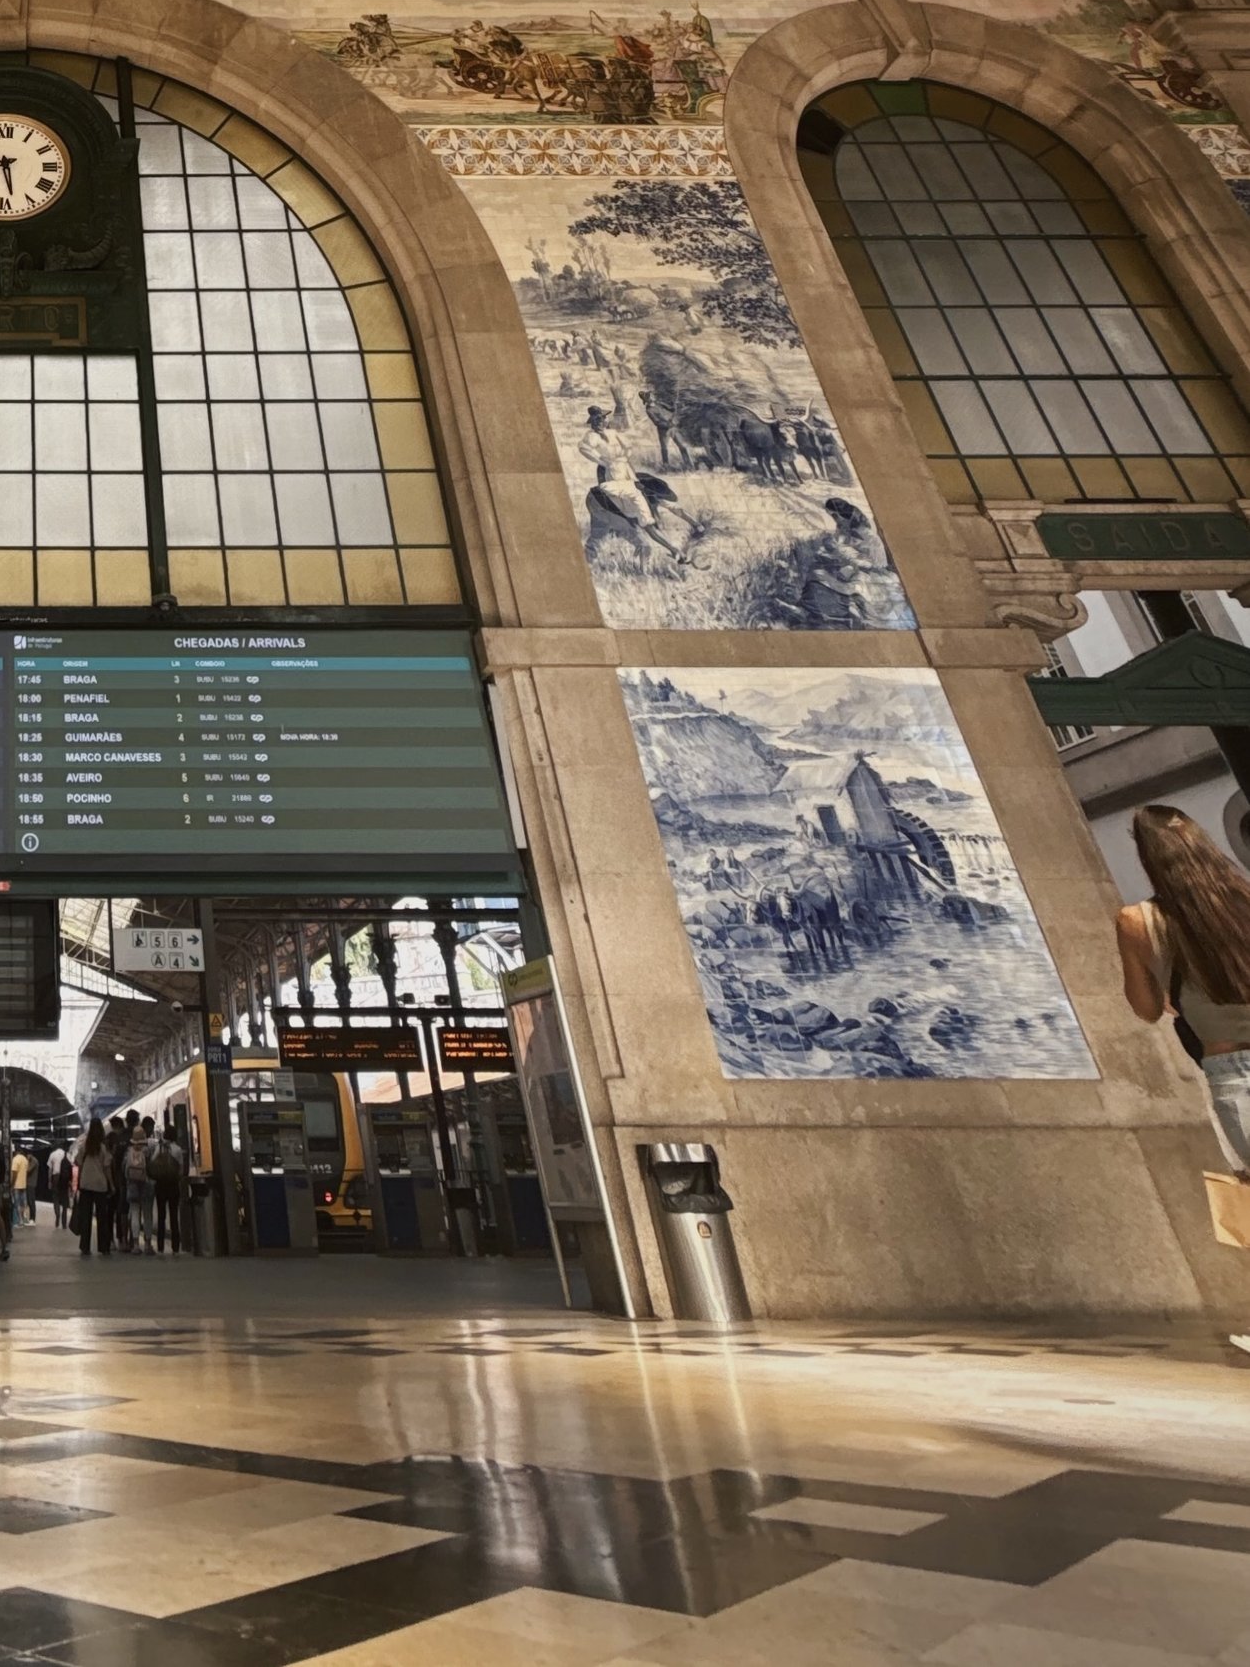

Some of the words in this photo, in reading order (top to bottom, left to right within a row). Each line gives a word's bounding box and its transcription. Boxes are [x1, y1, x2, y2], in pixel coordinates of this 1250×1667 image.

[174, 638, 239, 648] CHEGADAS
[249, 638, 305, 648] ARRIVALS
[18, 675, 41, 683] 17:45
[64, 676, 97, 684] BRAGA
[174, 675, 179, 683] 3
[18, 694, 41, 702] 18:00
[64, 694, 109, 703] PENAFIEL
[176, 694, 180, 702] 1
[18, 713, 42, 722] 18:15
[65, 714, 99, 722] BRAGA
[177, 714, 182, 722] 2
[19, 733, 42, 742] 18:25
[65, 732, 122, 742] GUIMARÃES
[179, 733, 184, 741] 4
[19, 753, 42, 762] 18:30
[66, 753, 101, 761] MARCO
[104, 753, 161, 762] CANAVESES
[180, 753, 185, 761] 3
[19, 773, 43, 782] 18:35
[66, 773, 102, 782] AVEIRO
[182, 773, 187, 782] 5
[19, 794, 43, 803] 18:50
[67, 794, 111, 803] POCINHO
[183, 794, 189, 802] 6
[19, 815, 43, 824] 18:55
[68, 815, 103, 824] BRAGA
[185, 815, 190, 824] 2
[155, 937, 161, 947] 5
[172, 937, 178, 947] 6
[155, 954, 163, 966] A
[173, 958, 179, 968] 4
